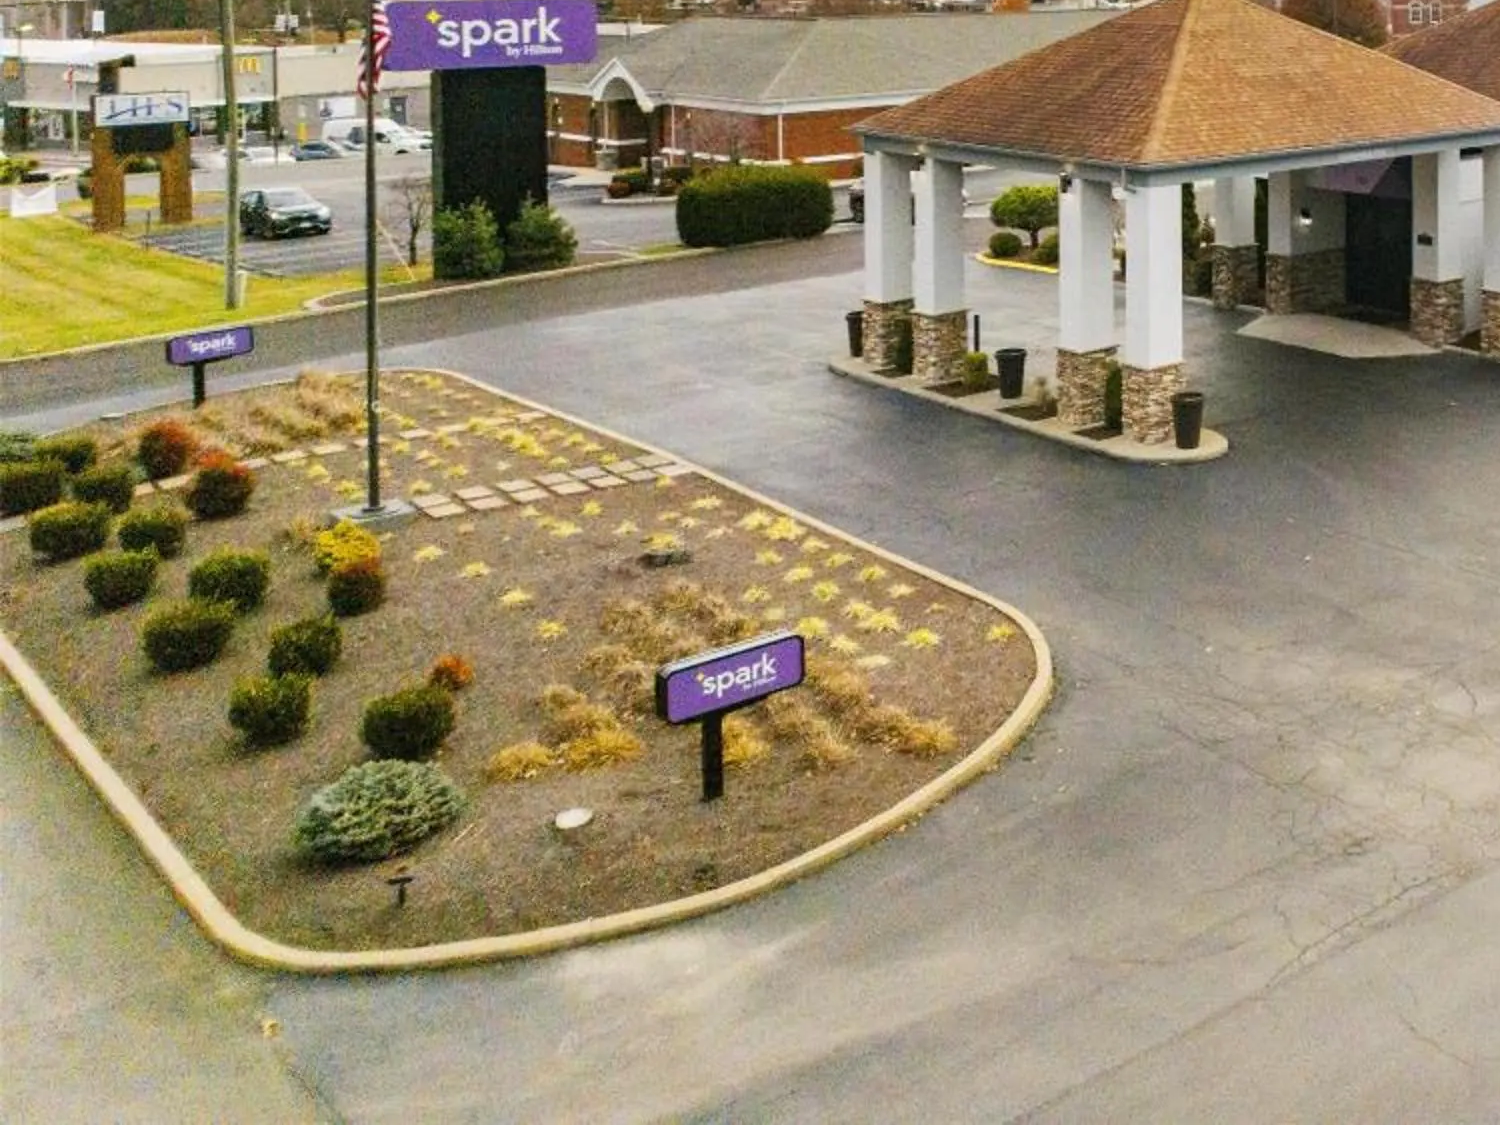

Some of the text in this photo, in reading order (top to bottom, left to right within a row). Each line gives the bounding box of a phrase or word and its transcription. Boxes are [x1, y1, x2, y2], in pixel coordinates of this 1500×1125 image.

[437, 6, 562, 58] spark
[506, 46, 520, 59] by
[190, 333, 236, 354] spark
[702, 652, 777, 698] spark
